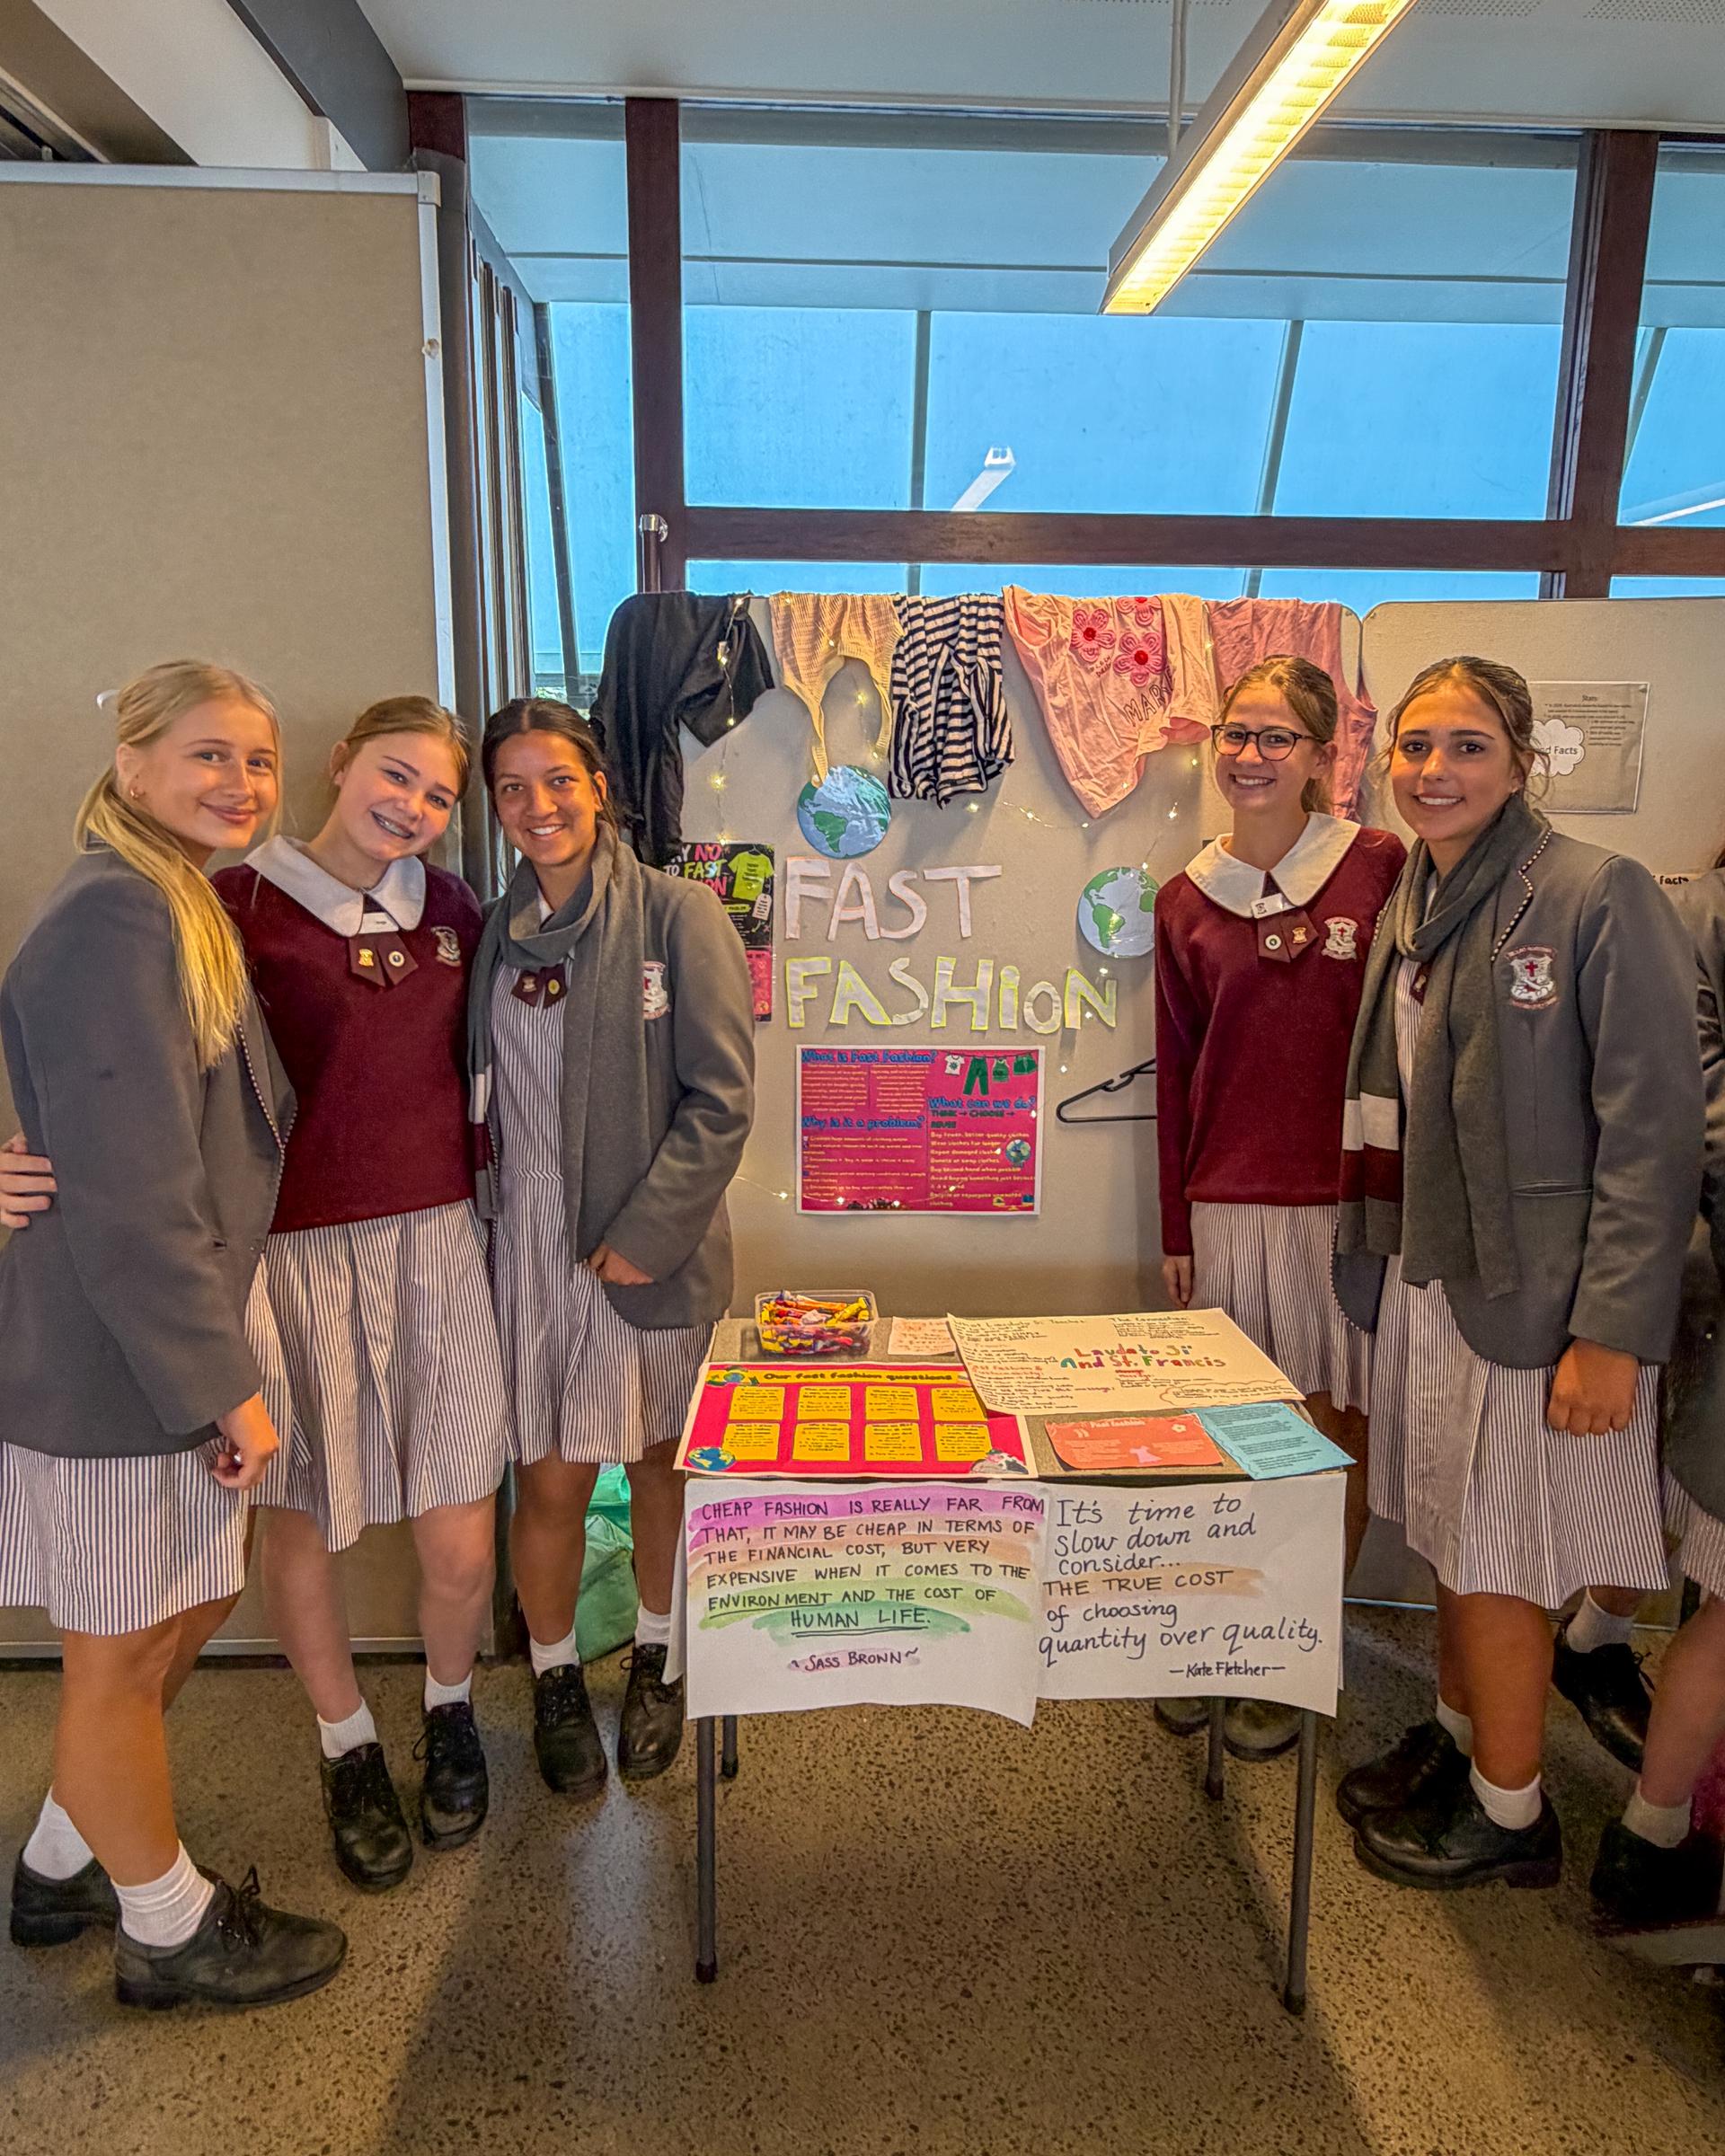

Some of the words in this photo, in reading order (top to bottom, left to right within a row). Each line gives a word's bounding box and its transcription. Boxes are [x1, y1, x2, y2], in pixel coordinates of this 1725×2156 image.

[1554, 747, 1578, 755] Facts
[694, 844, 722, 861] NO
[663, 864, 680, 877] TO
[684, 859, 728, 879] FAST
[784, 856, 1003, 941] FAST
[801, 1049, 834, 1063] What
[850, 1049, 879, 1063] Fast
[929, 1097, 963, 1109] What
[966, 1100, 990, 1108] can
[993, 1100, 1010, 1109] we
[1014, 1096, 1036, 1109] do?
[801, 1116, 826, 1130] Why
[867, 1115, 925, 1130] problem?
[1074, 1343, 1160, 1357] Laudato
[1060, 1356, 1106, 1369] And
[1109, 1355, 1138, 1367] St.
[1142, 1355, 1226, 1367] Francis
[703, 1501, 753, 1520] CHEAP
[764, 1500, 828, 1516] FASHION
[849, 1500, 862, 1514] IS
[871, 1497, 931, 1513] REALLY
[946, 1498, 982, 1512] FAR
[1002, 1496, 1044, 1515] FROM
[1057, 1499, 1103, 1527] It's
[1128, 1499, 1196, 1524] time
[1213, 1493, 1242, 1515] to
[702, 1526, 751, 1544] THAT,
[763, 1526, 777, 1540] IT
[784, 1524, 817, 1541] MAY
[823, 1524, 845, 1539] BE
[855, 1522, 907, 1537] CHEAP
[917, 1520, 933, 1534] IN
[945, 1519, 1003, 1534] TERMS
[1013, 1520, 1035, 1534] OF
[1127, 1526, 1191, 1550] down
[1207, 1512, 1257, 1538] and
[703, 1551, 737, 1565] THE
[748, 1545, 833, 1562] FINANCIAL
[902, 1542, 933, 1555] BUT
[945, 1539, 990, 1554] VERY
[706, 1568, 798, 1589] EXPENSIVE
[814, 1564, 862, 1581] WHEN
[876, 1563, 890, 1577] IT
[905, 1563, 959, 1577] COMES
[969, 1563, 992, 1577] TO
[999, 1564, 1031, 1580] THE
[1043, 1580, 1090, 1596] THE
[1102, 1577, 1163, 1592] TRUE
[1175, 1570, 1234, 1587] COST
[842, 1587, 876, 1604] AND
[886, 1587, 916, 1601] THE
[924, 1586, 963, 1600] COST
[975, 1589, 997, 1602] OF
[791, 1609, 859, 1627] HUMAN
[1047, 1605, 1069, 1632] of
[1083, 1600, 1178, 1628] choosing
[1039, 1626, 1147, 1668] quantity
[1160, 1626, 1215, 1647] over
